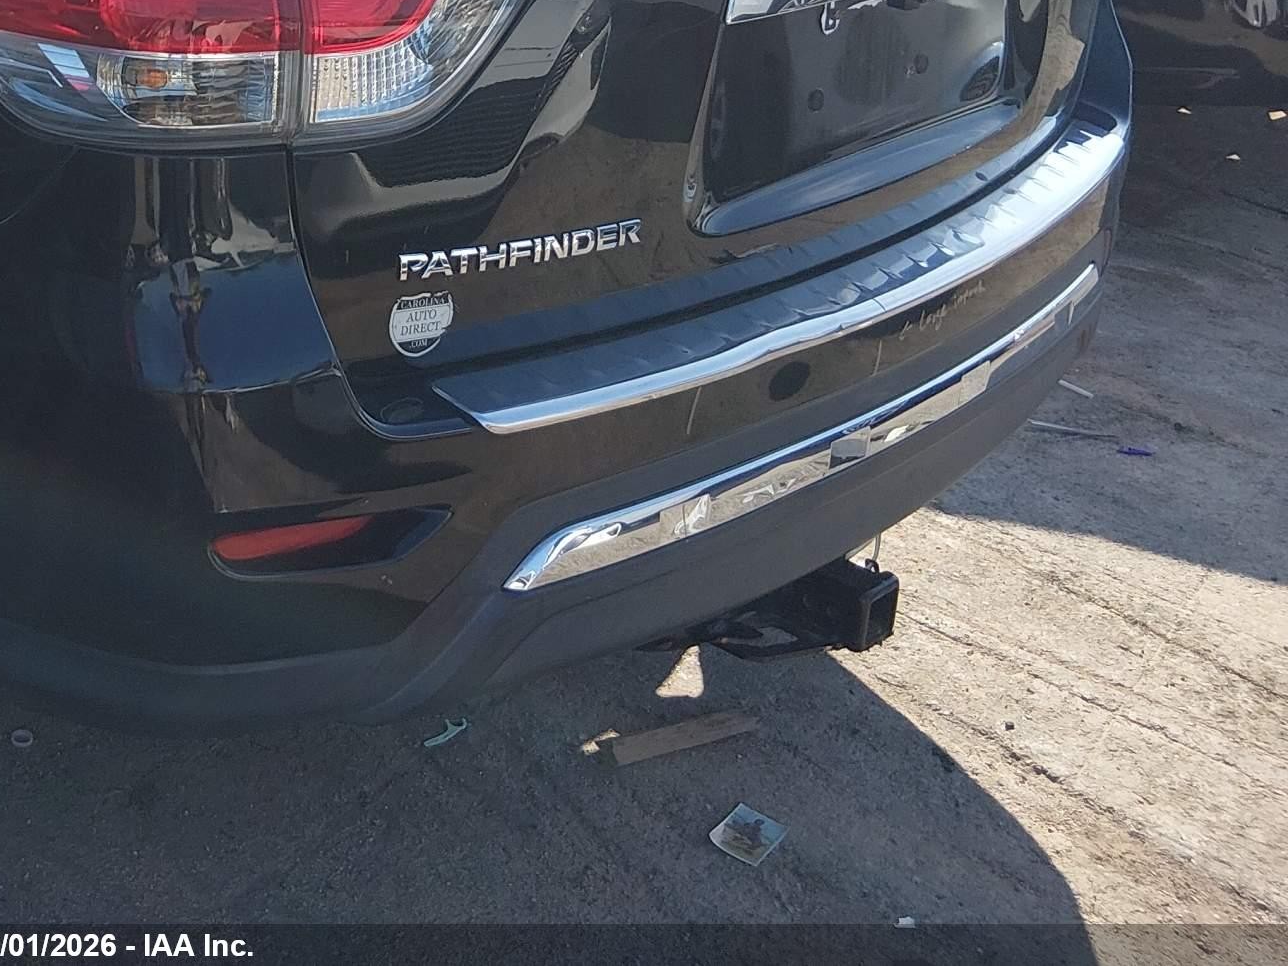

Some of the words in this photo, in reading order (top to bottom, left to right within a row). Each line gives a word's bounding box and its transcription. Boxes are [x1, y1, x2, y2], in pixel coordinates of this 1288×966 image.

[398, 218, 642, 281] PATHFINDER
[400, 296, 446, 309] CAROLINA
[406, 309, 437, 323] AUTO
[400, 321, 441, 336] DIRECT
